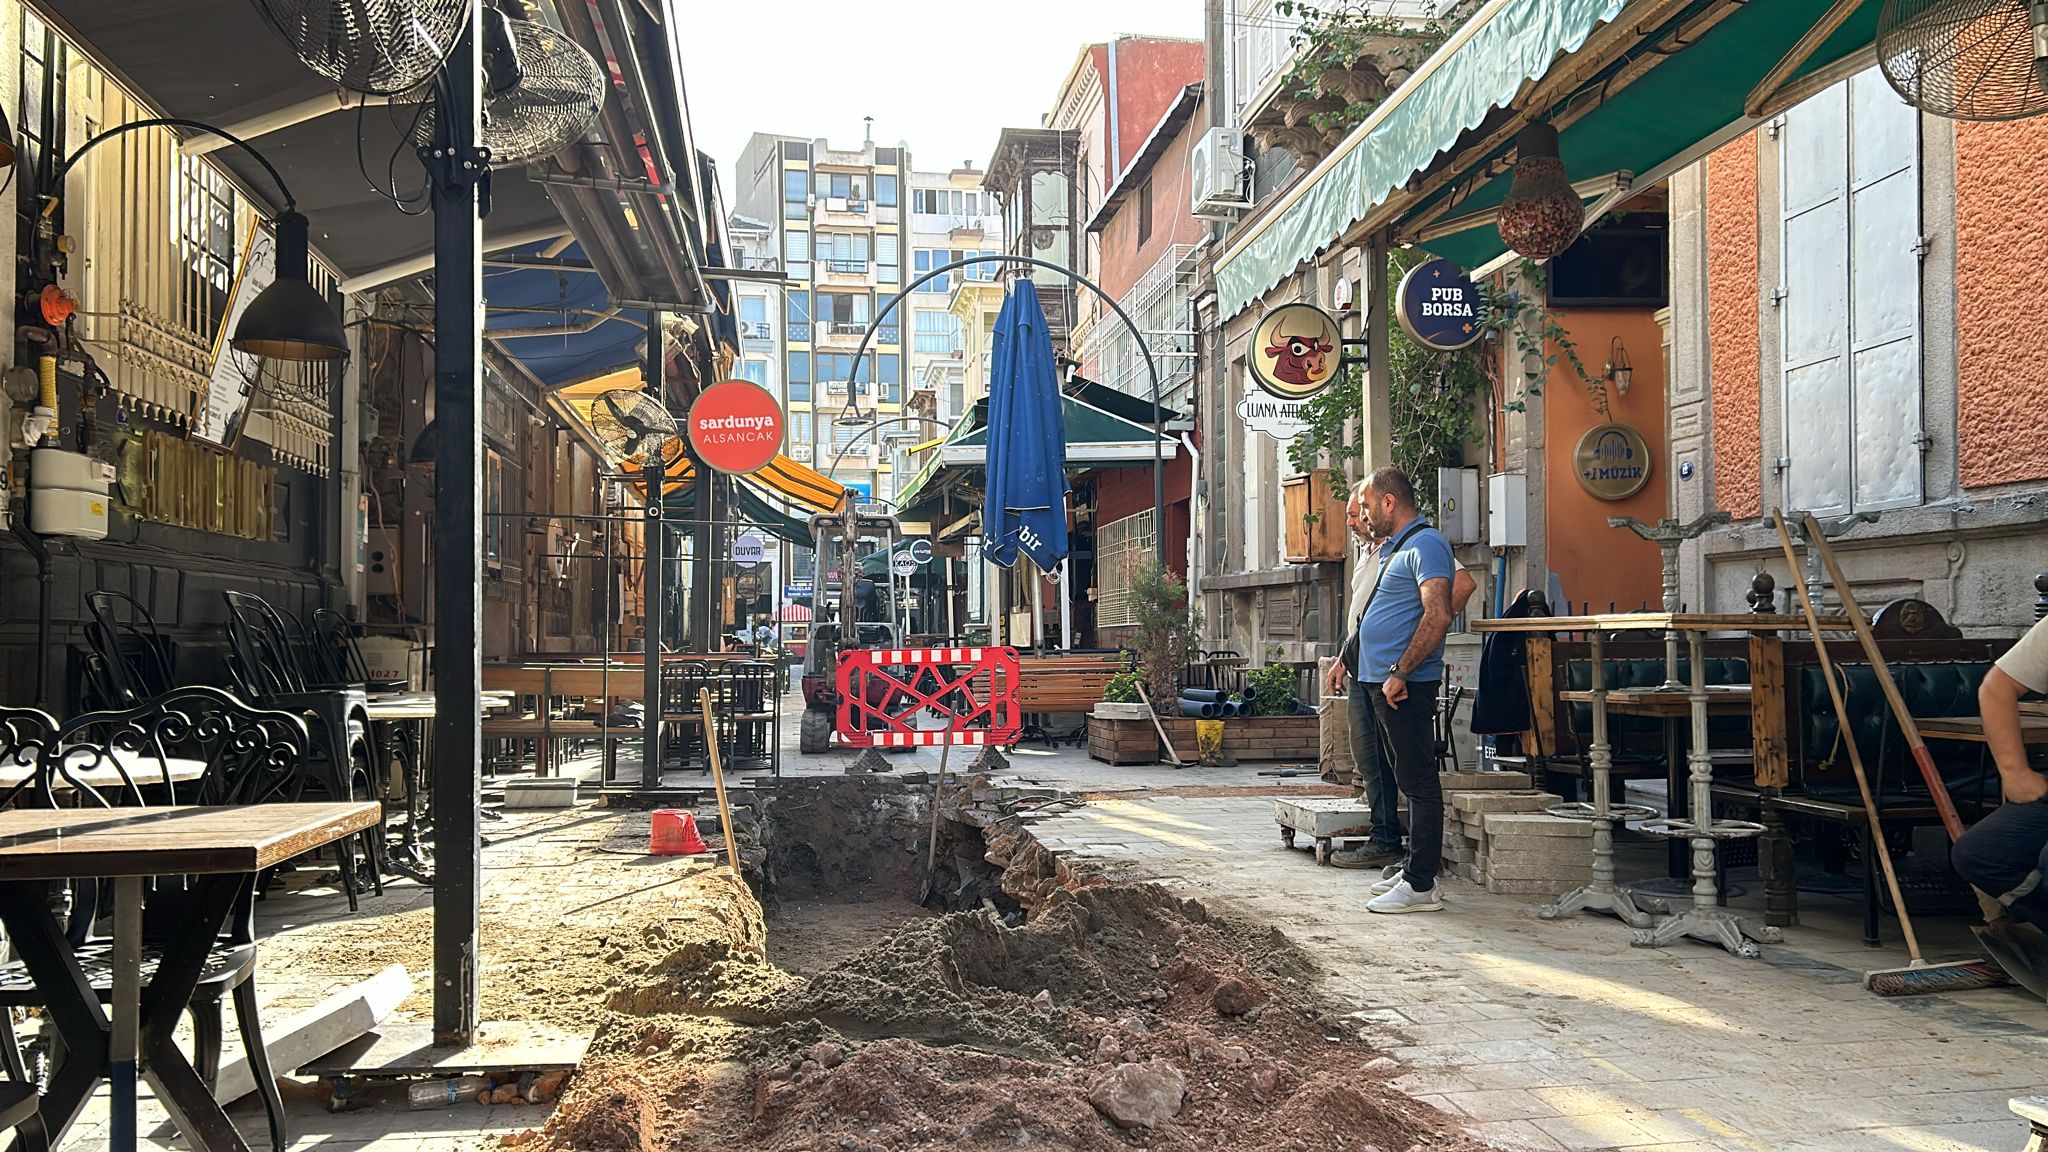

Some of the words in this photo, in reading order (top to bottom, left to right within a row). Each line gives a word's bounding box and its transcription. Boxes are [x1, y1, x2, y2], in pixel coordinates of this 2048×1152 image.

[1431, 287, 1463, 301] PUB
[1422, 302, 1473, 317] BORSA
[1247, 403, 1278, 418] LUANA
[699, 414, 774, 431] sardunya
[703, 431, 773, 444] ALSANCAK
[1598, 464, 1642, 479] MÜZİK
[1018, 525, 1042, 551] bir
[735, 546, 761, 556] DUVAR
[371, 670, 400, 678] 1027
